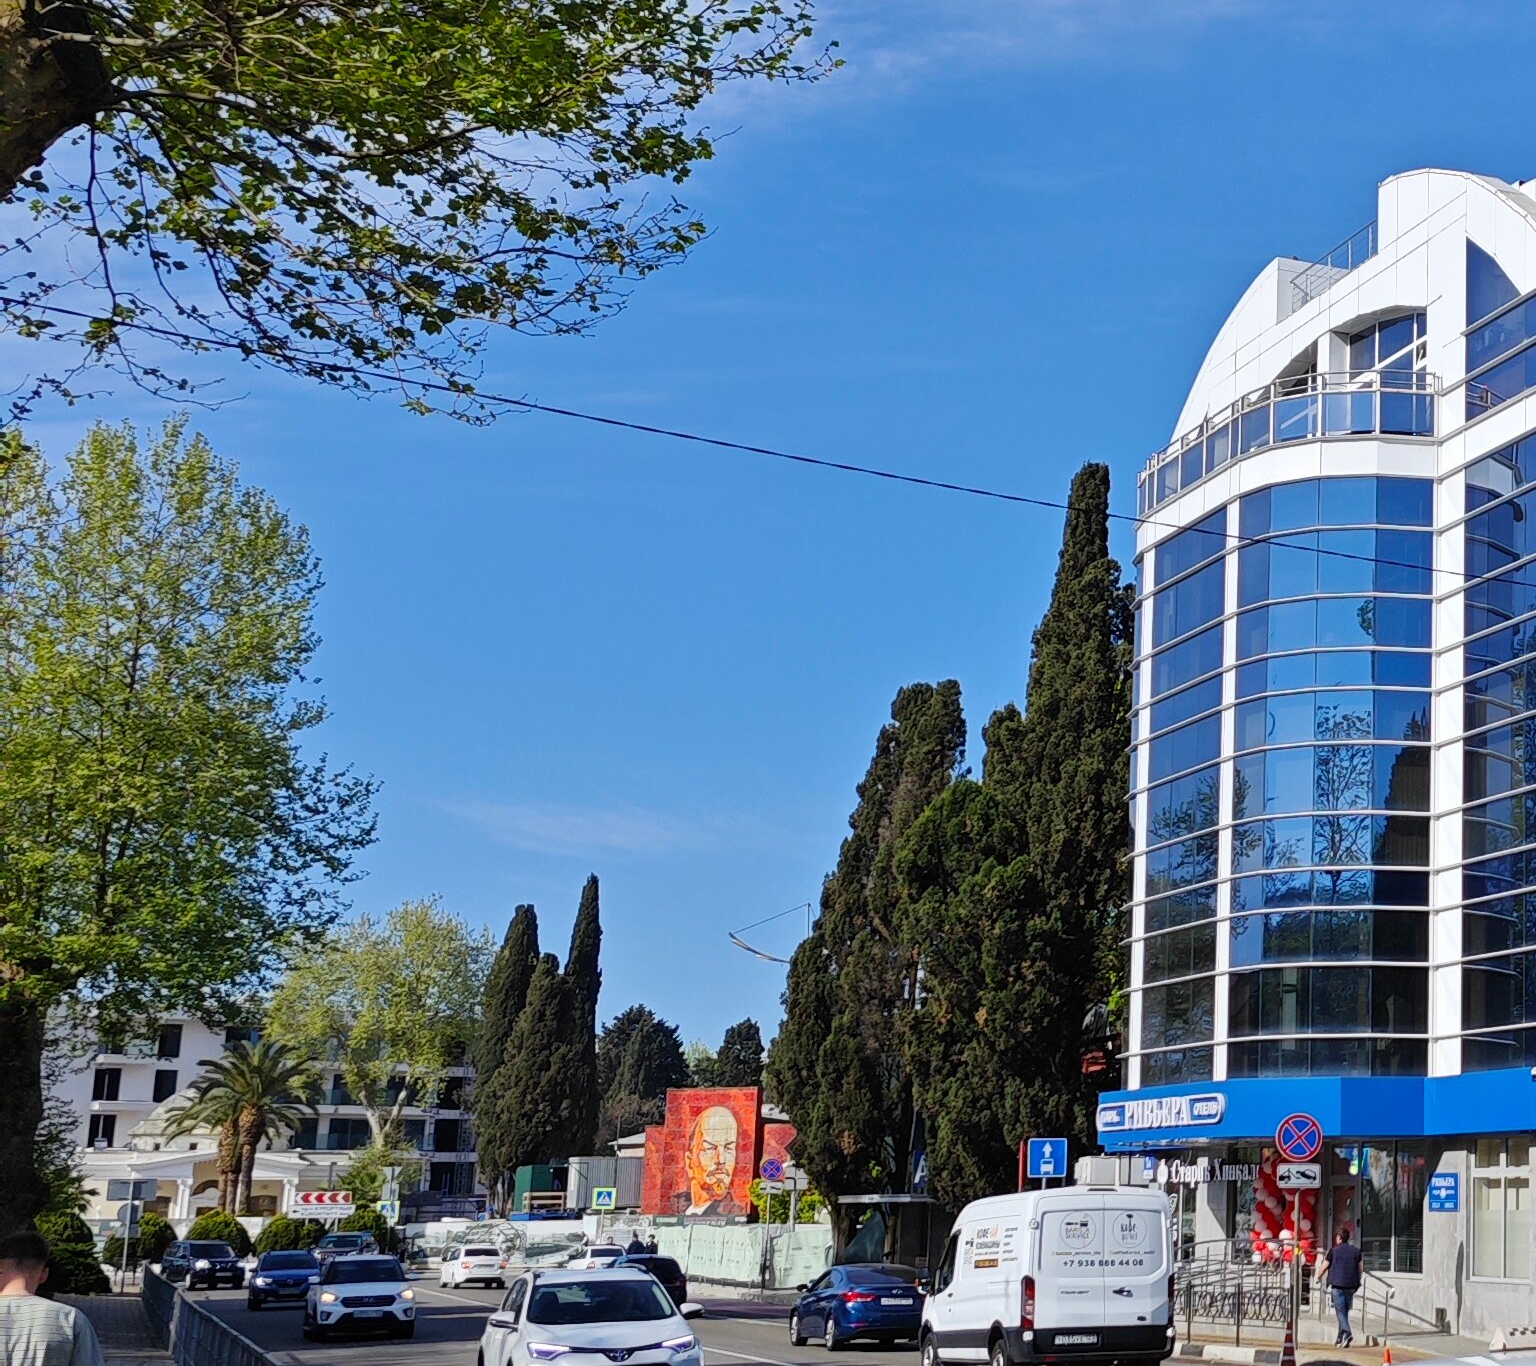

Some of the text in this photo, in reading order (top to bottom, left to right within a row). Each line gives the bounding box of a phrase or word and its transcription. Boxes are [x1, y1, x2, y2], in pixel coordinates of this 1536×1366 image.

[1125, 1096, 1191, 1128] РИВЬЕРА
[1169, 1159, 1211, 1189] Старик
[1213, 1157, 1260, 1181] Хинкал
[1063, 1259, 1075, 1267] +7
